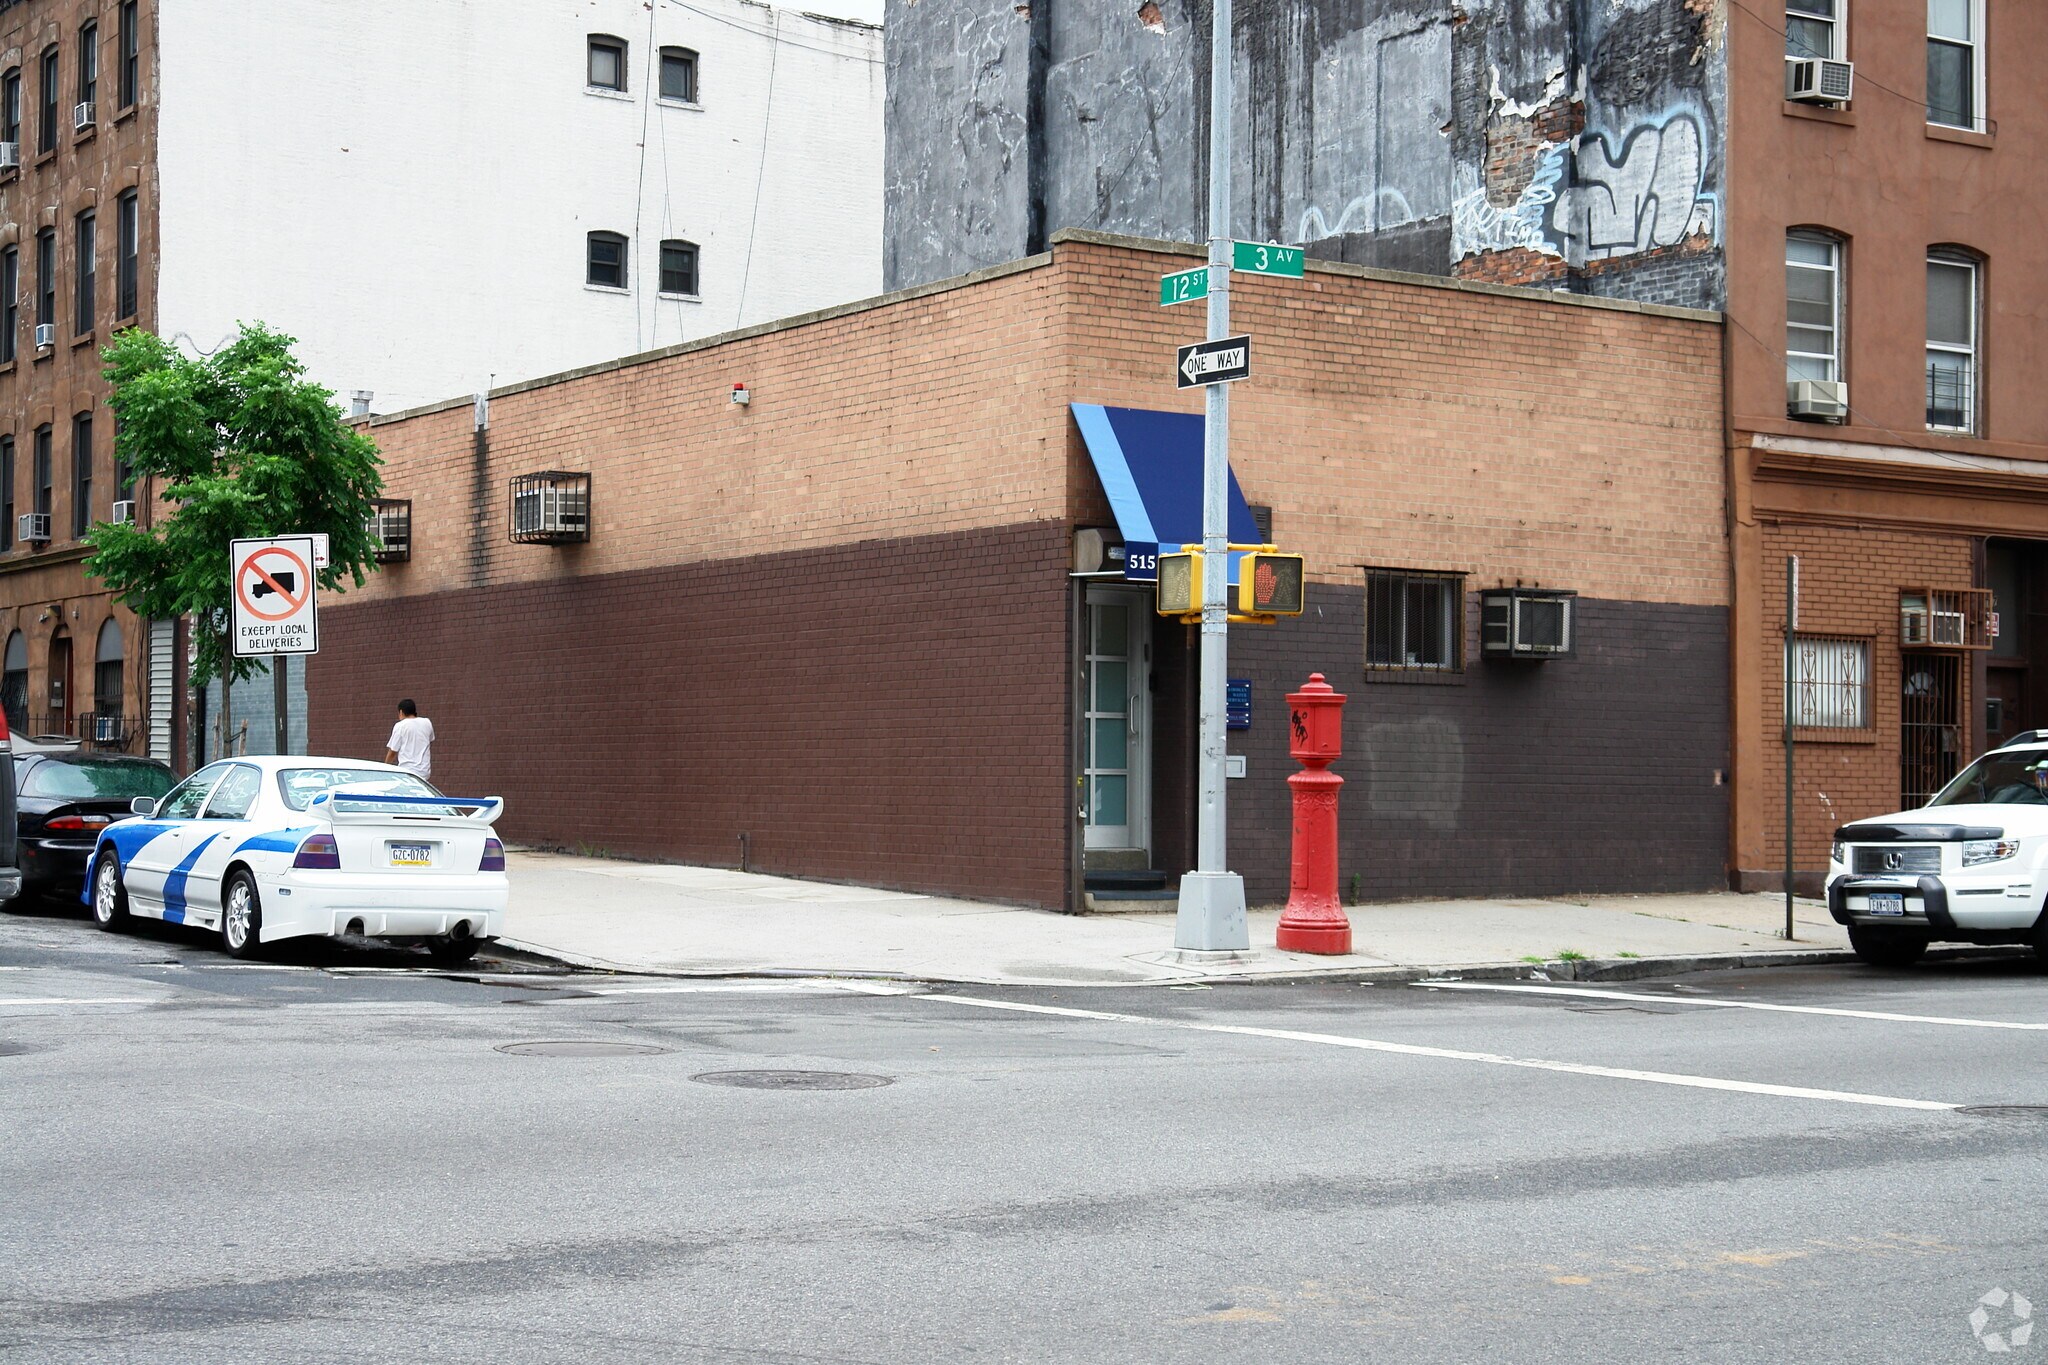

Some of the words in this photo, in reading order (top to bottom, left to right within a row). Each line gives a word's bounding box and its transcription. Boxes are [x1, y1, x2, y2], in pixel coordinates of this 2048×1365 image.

[1255, 247, 1269, 270] 3
[1276, 249, 1294, 263] AV
[1173, 275, 1190, 300] 12
[1193, 272, 1204, 286] ST
[1187, 356, 1208, 374] ONE
[1217, 350, 1240, 369] WAY
[1130, 554, 1156, 570] 515
[241, 625, 276, 637] EXCEPT
[280, 624, 309, 635] LOCAL
[249, 637, 302, 649] DELIVERIES
